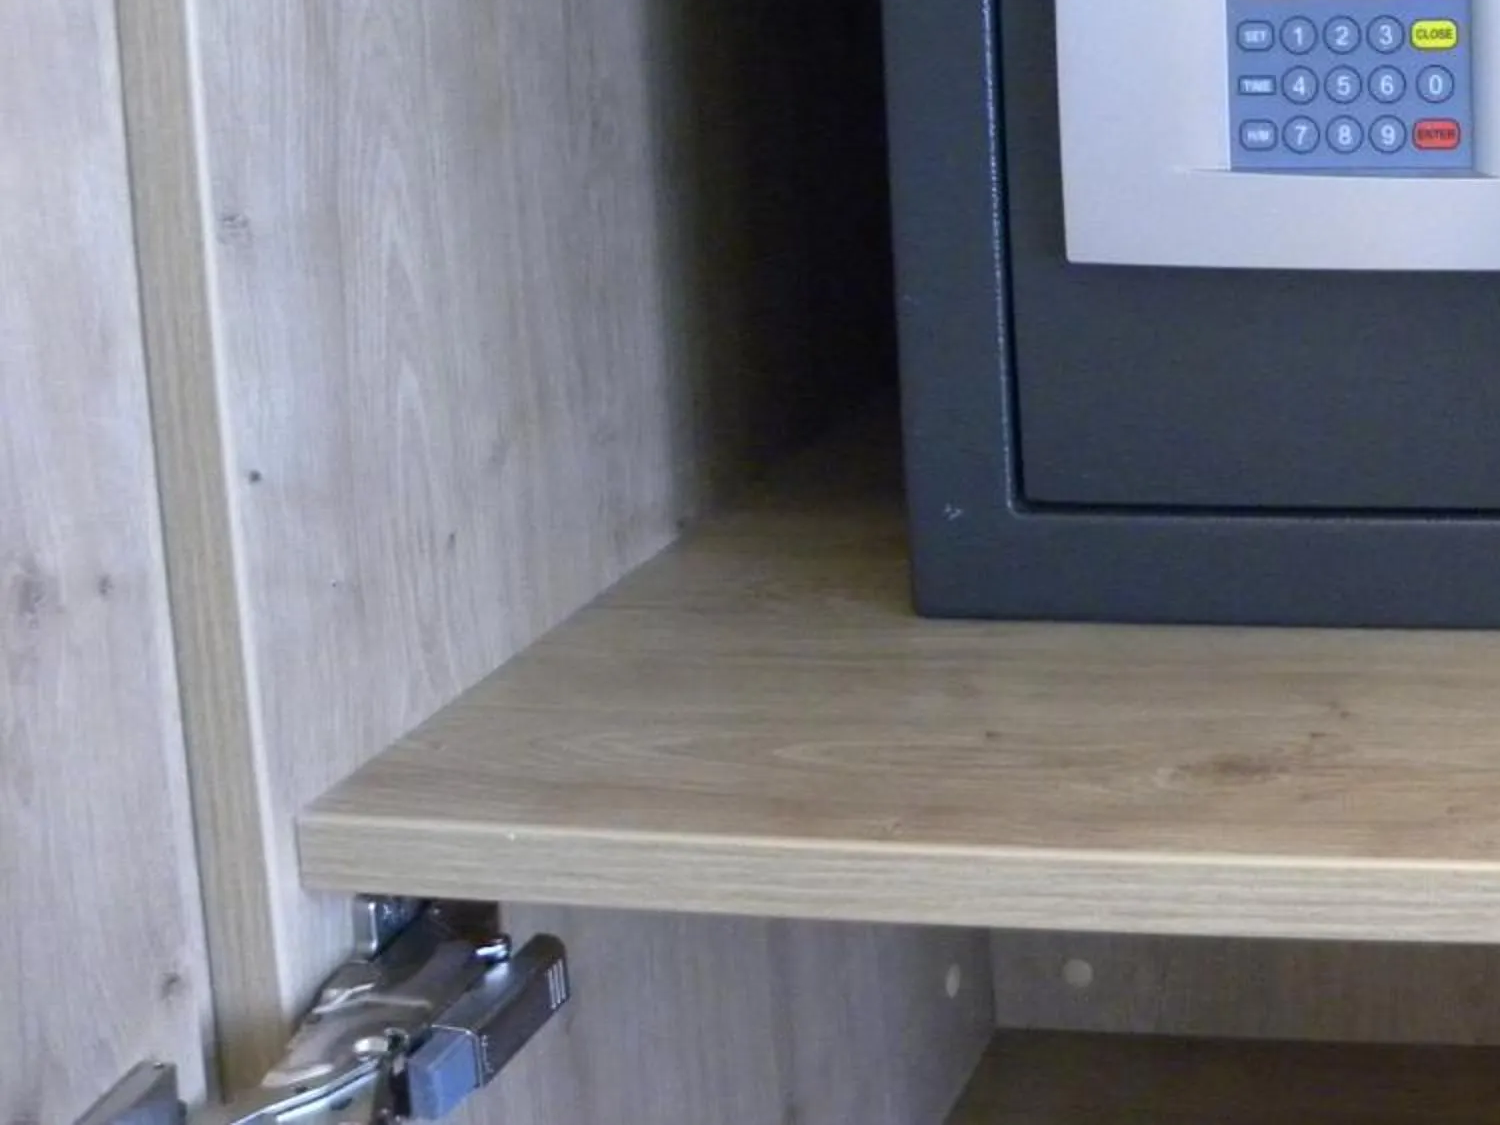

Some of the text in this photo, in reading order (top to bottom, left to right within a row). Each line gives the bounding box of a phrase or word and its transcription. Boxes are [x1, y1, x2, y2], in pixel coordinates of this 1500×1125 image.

[1293, 28, 1303, 45] 1
[1335, 27, 1348, 45] 2
[1380, 26, 1393, 44] 3
[1415, 29, 1454, 40] CLOSE
[1293, 78, 1305, 95] 4
[1336, 77, 1350, 95] 5
[1380, 76, 1394, 95] 6
[1429, 76, 1443, 95] 0
[1295, 127, 1307, 145] 7
[1337, 126, 1351, 145] 8
[1381, 126, 1395, 145] 9
[1417, 128, 1456, 141] ENTER
